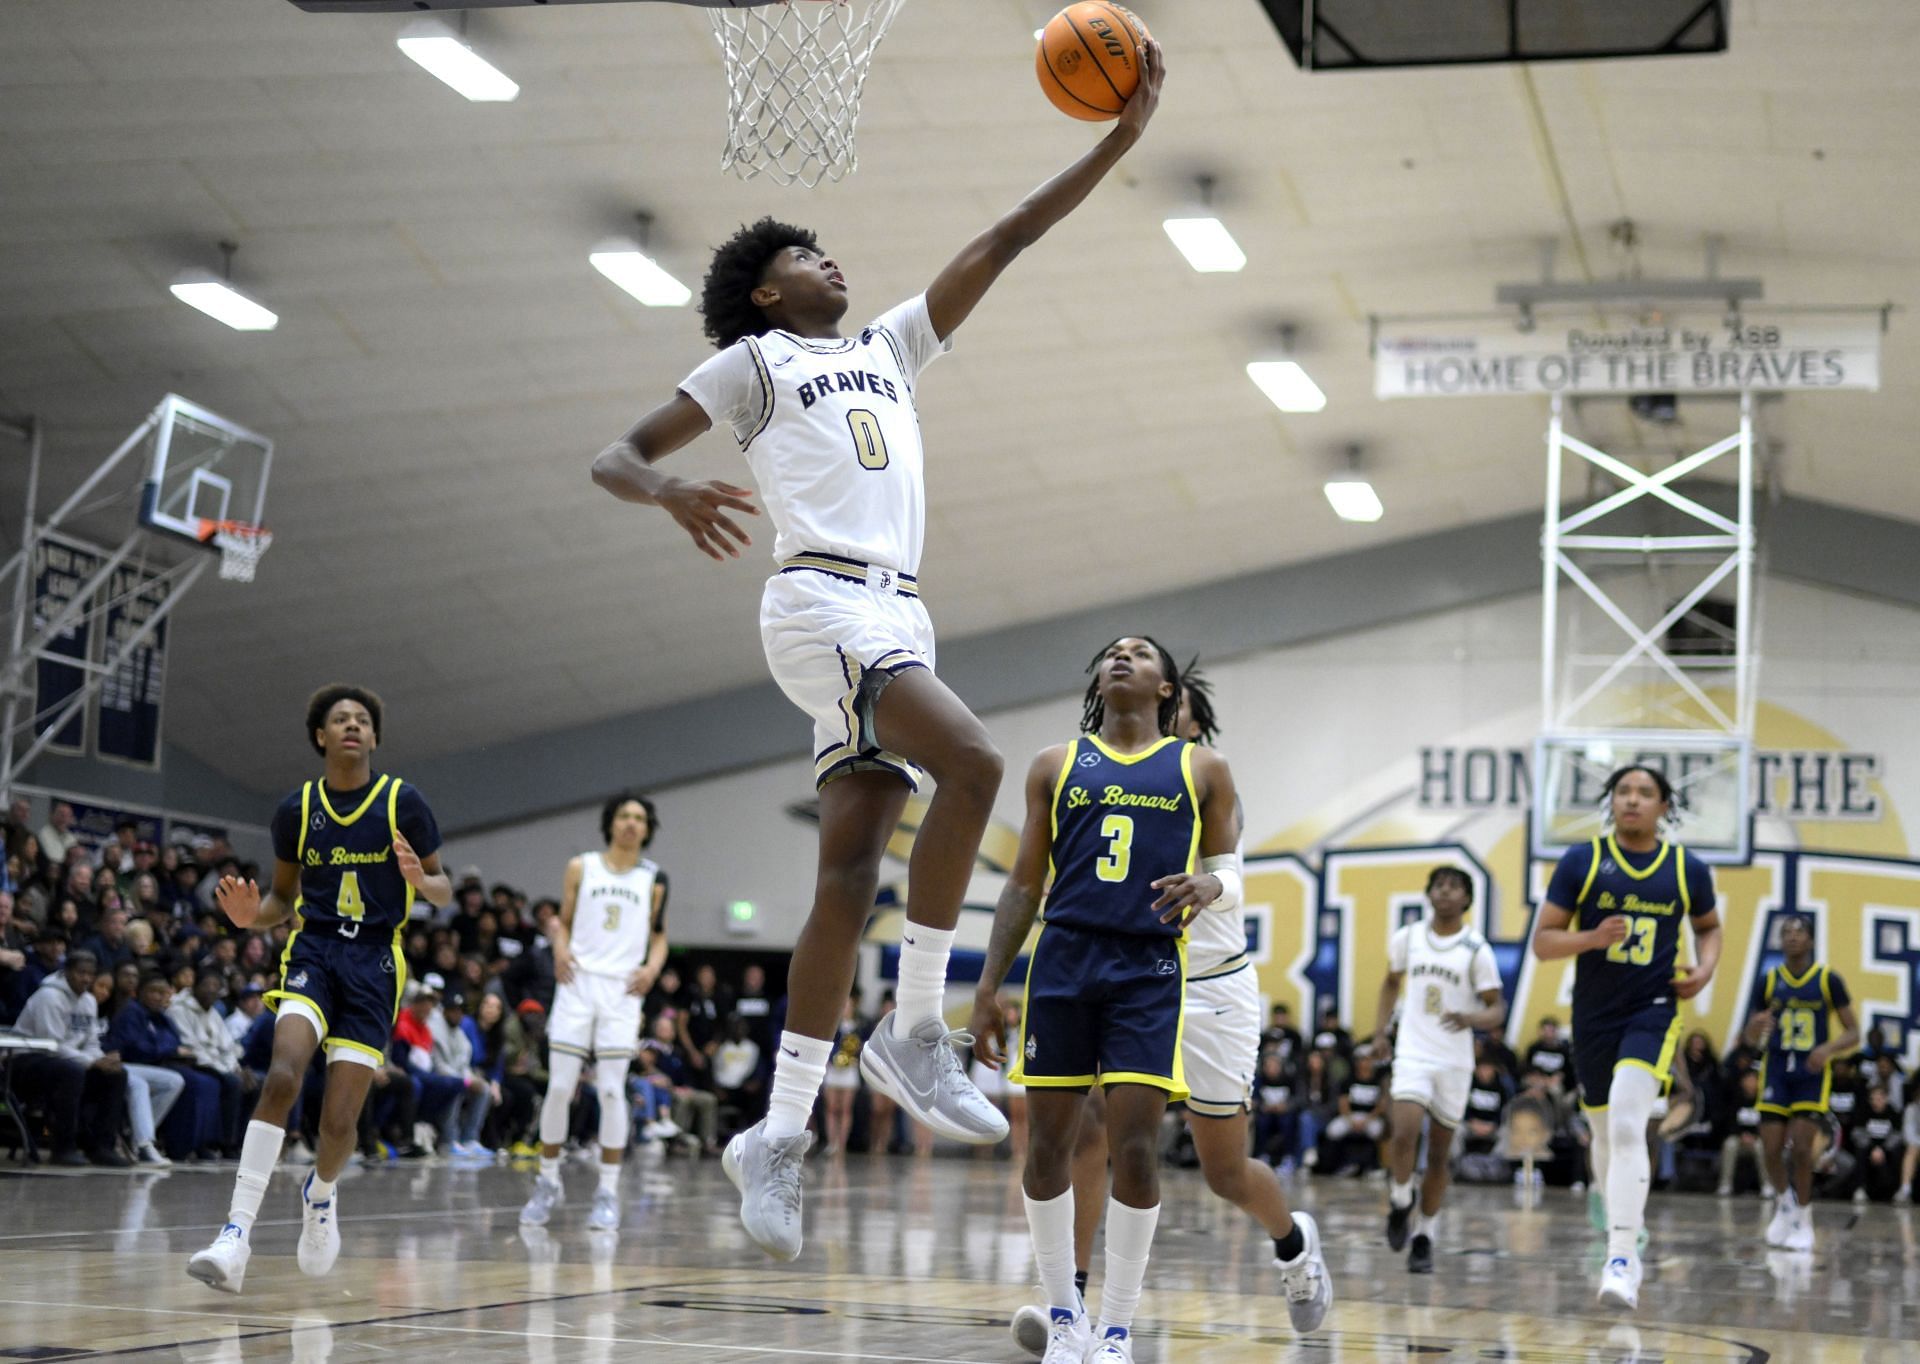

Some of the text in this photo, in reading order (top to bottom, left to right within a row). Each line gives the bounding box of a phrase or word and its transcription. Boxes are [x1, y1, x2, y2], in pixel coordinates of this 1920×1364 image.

[1088, 18, 1126, 56] EVO
[1568, 328, 1670, 352] Donated
[1681, 330, 1712, 353] by
[796, 370, 898, 410] BRAVES
[1405, 350, 1845, 393] HOME OF THE BRAVES
[845, 408, 889, 470] 0
[1067, 784, 1183, 812] St. Bernard
[1755, 752, 1876, 813] THE
[306, 845, 390, 867] St. Bernard
[1095, 814, 1134, 883] 3
[336, 871, 366, 922] 4
[602, 904, 622, 932] 3
[1606, 915, 1658, 966] 23
[1780, 1008, 1816, 1051] 13
